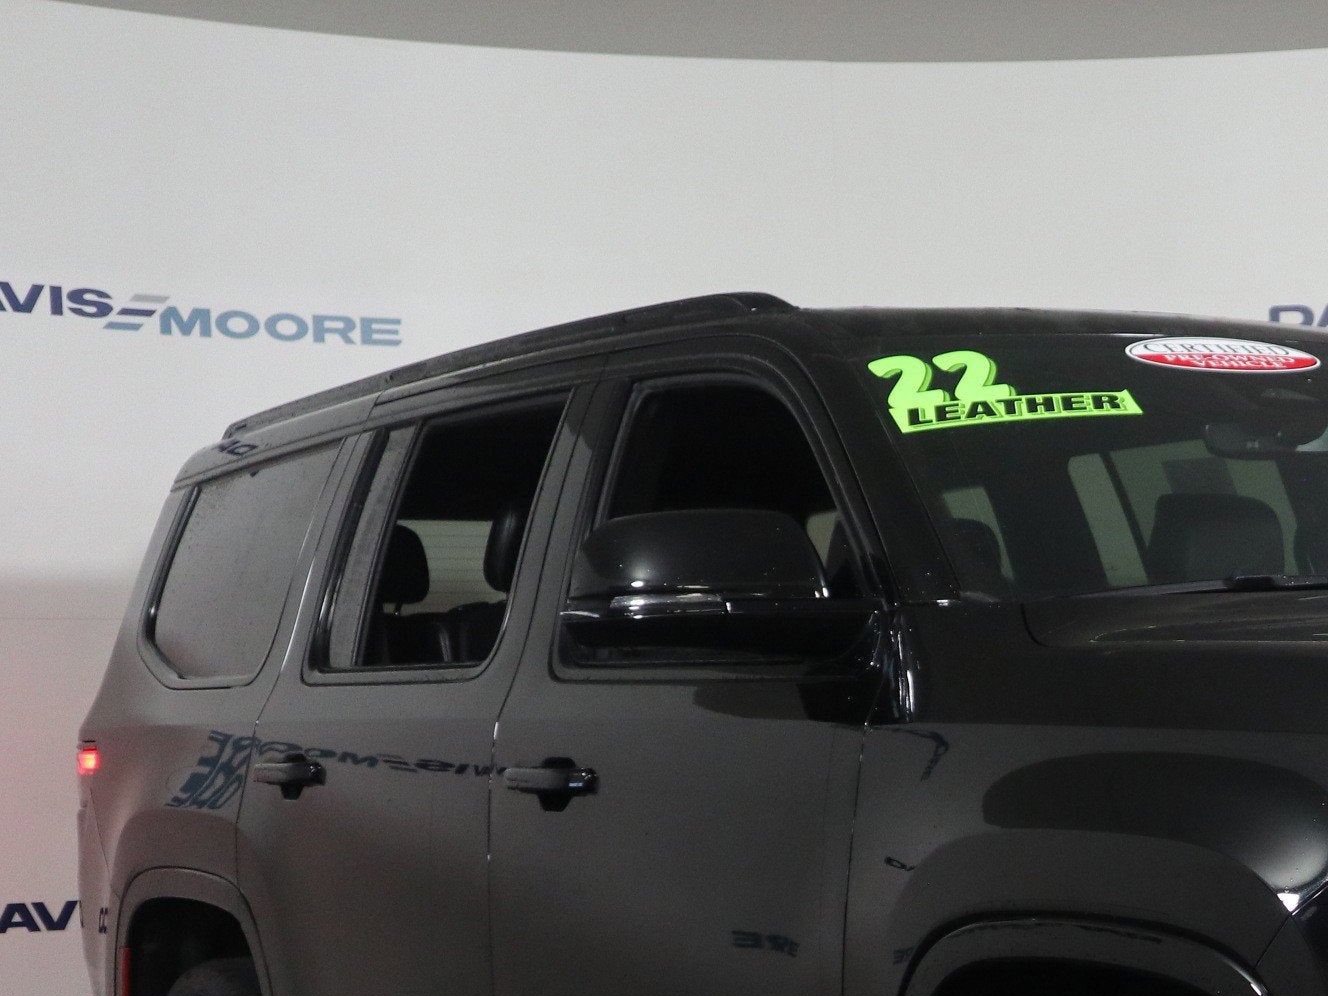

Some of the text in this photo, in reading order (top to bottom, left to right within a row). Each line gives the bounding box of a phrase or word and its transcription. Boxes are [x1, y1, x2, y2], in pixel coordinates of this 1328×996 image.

[0, 281, 402, 346] VIS MOORE
[1143, 342, 1290, 356] CERTIFIED
[867, 350, 1016, 408] 22
[907, 393, 1129, 426] LEATHER
